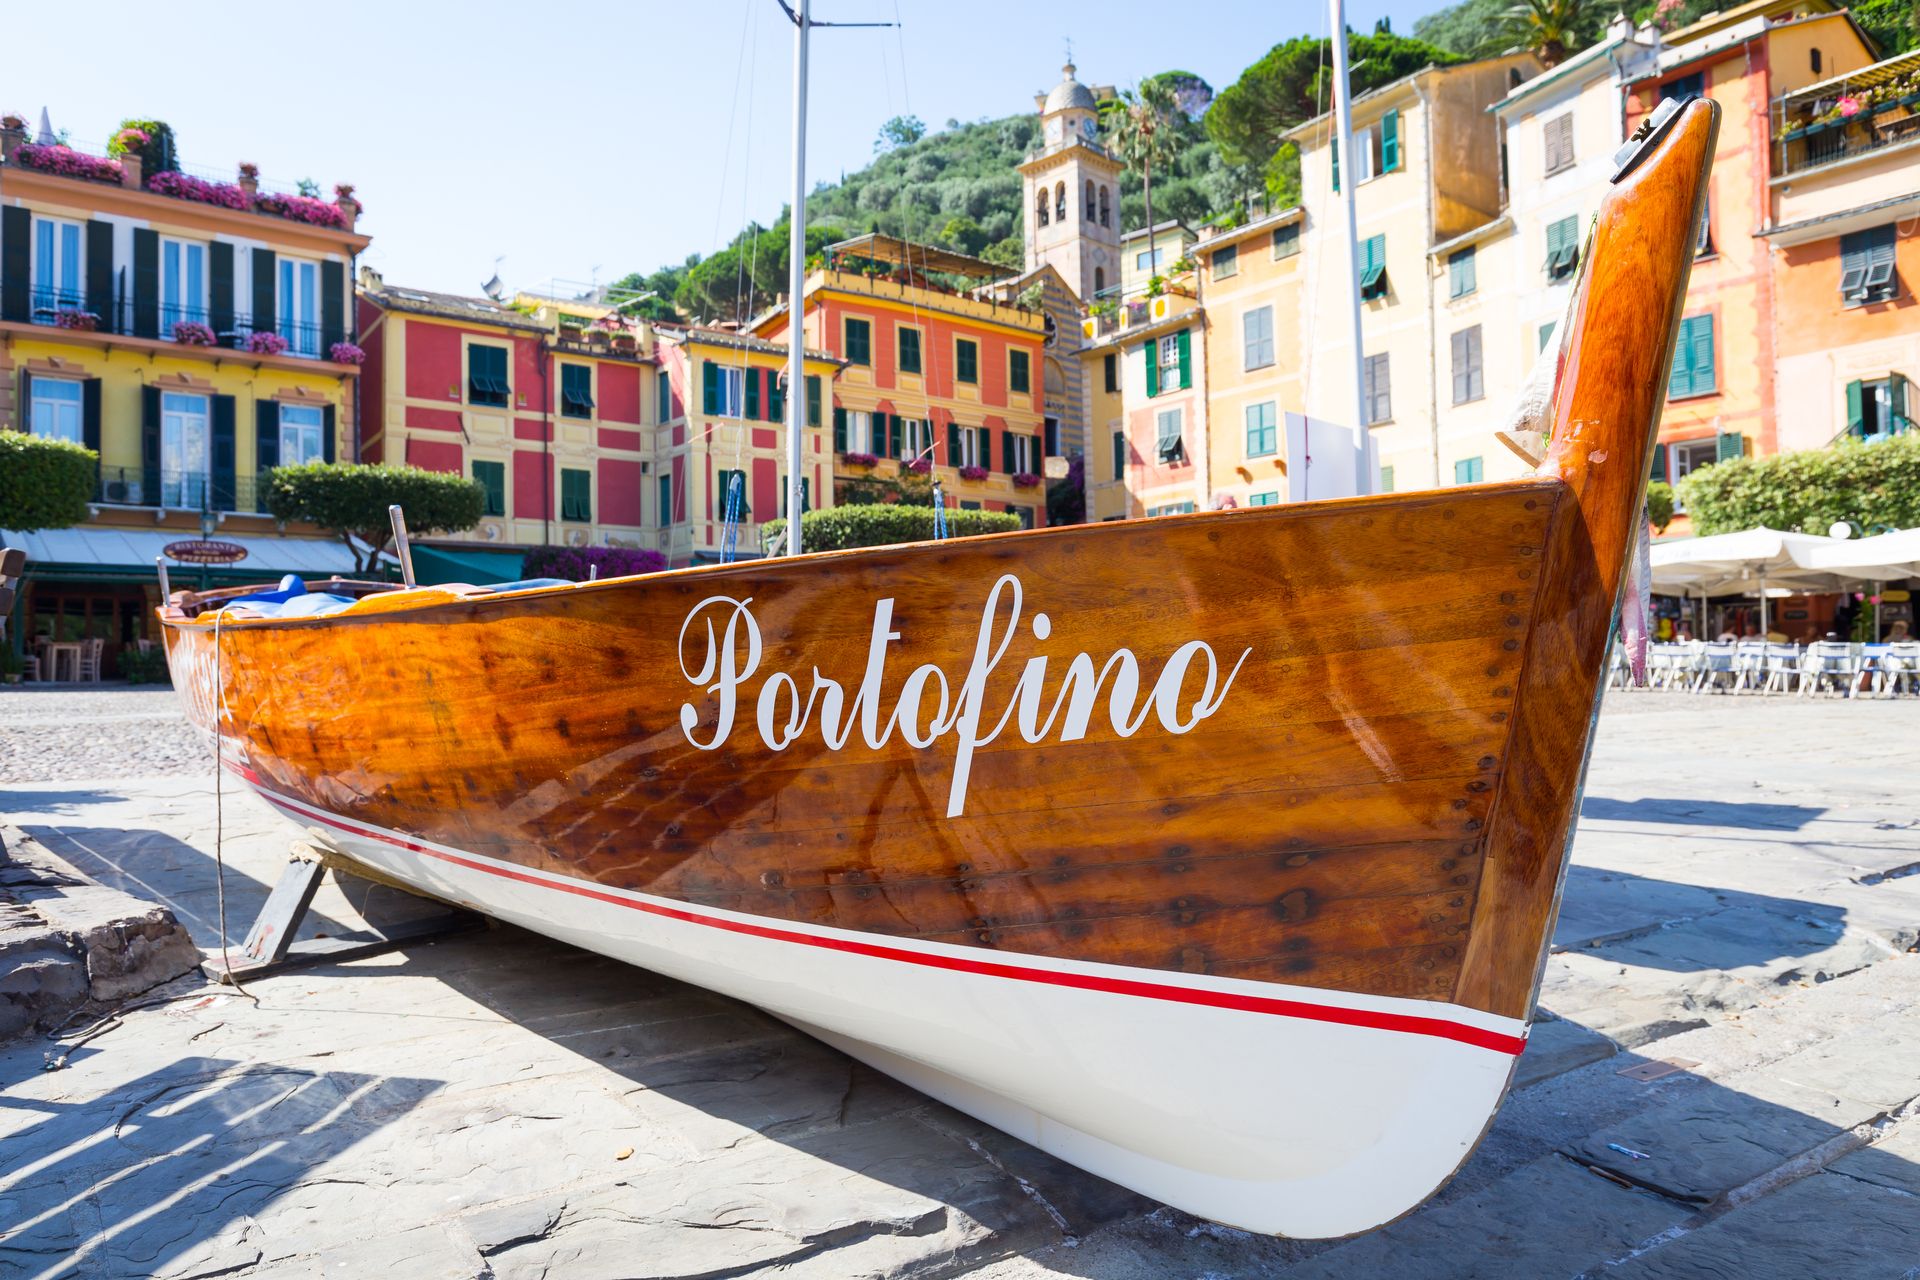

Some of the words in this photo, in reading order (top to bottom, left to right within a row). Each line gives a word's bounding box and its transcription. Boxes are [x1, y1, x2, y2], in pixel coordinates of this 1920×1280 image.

[175, 541, 237, 552] RISTORANTE
[181, 554, 232, 562] PIZZERIA
[678, 573, 1253, 818] Portofino
